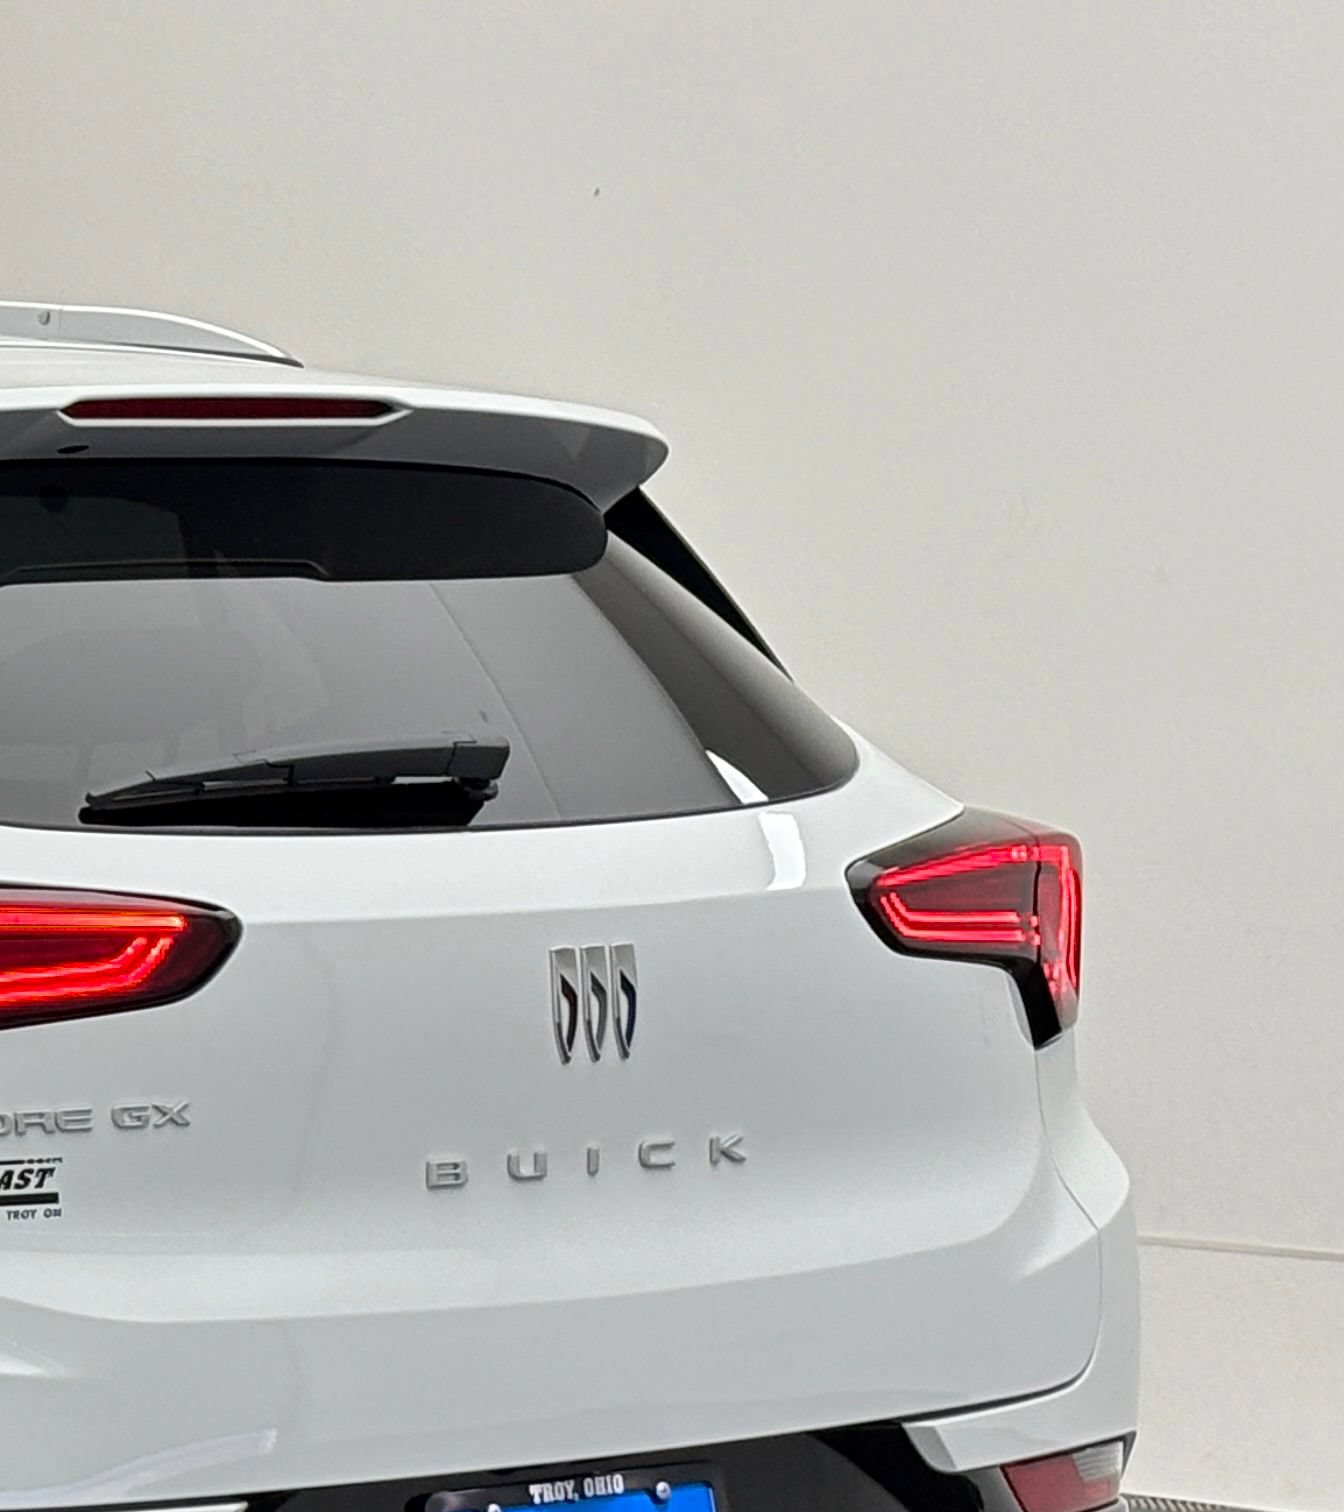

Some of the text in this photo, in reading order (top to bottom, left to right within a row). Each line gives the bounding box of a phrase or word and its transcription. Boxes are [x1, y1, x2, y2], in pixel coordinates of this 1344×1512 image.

[111, 1101, 192, 1131] GX
[425, 1135, 747, 1190] BUICK
[6, 1209, 37, 1221] TROY
[583, 1474, 624, 1497] OHIO
